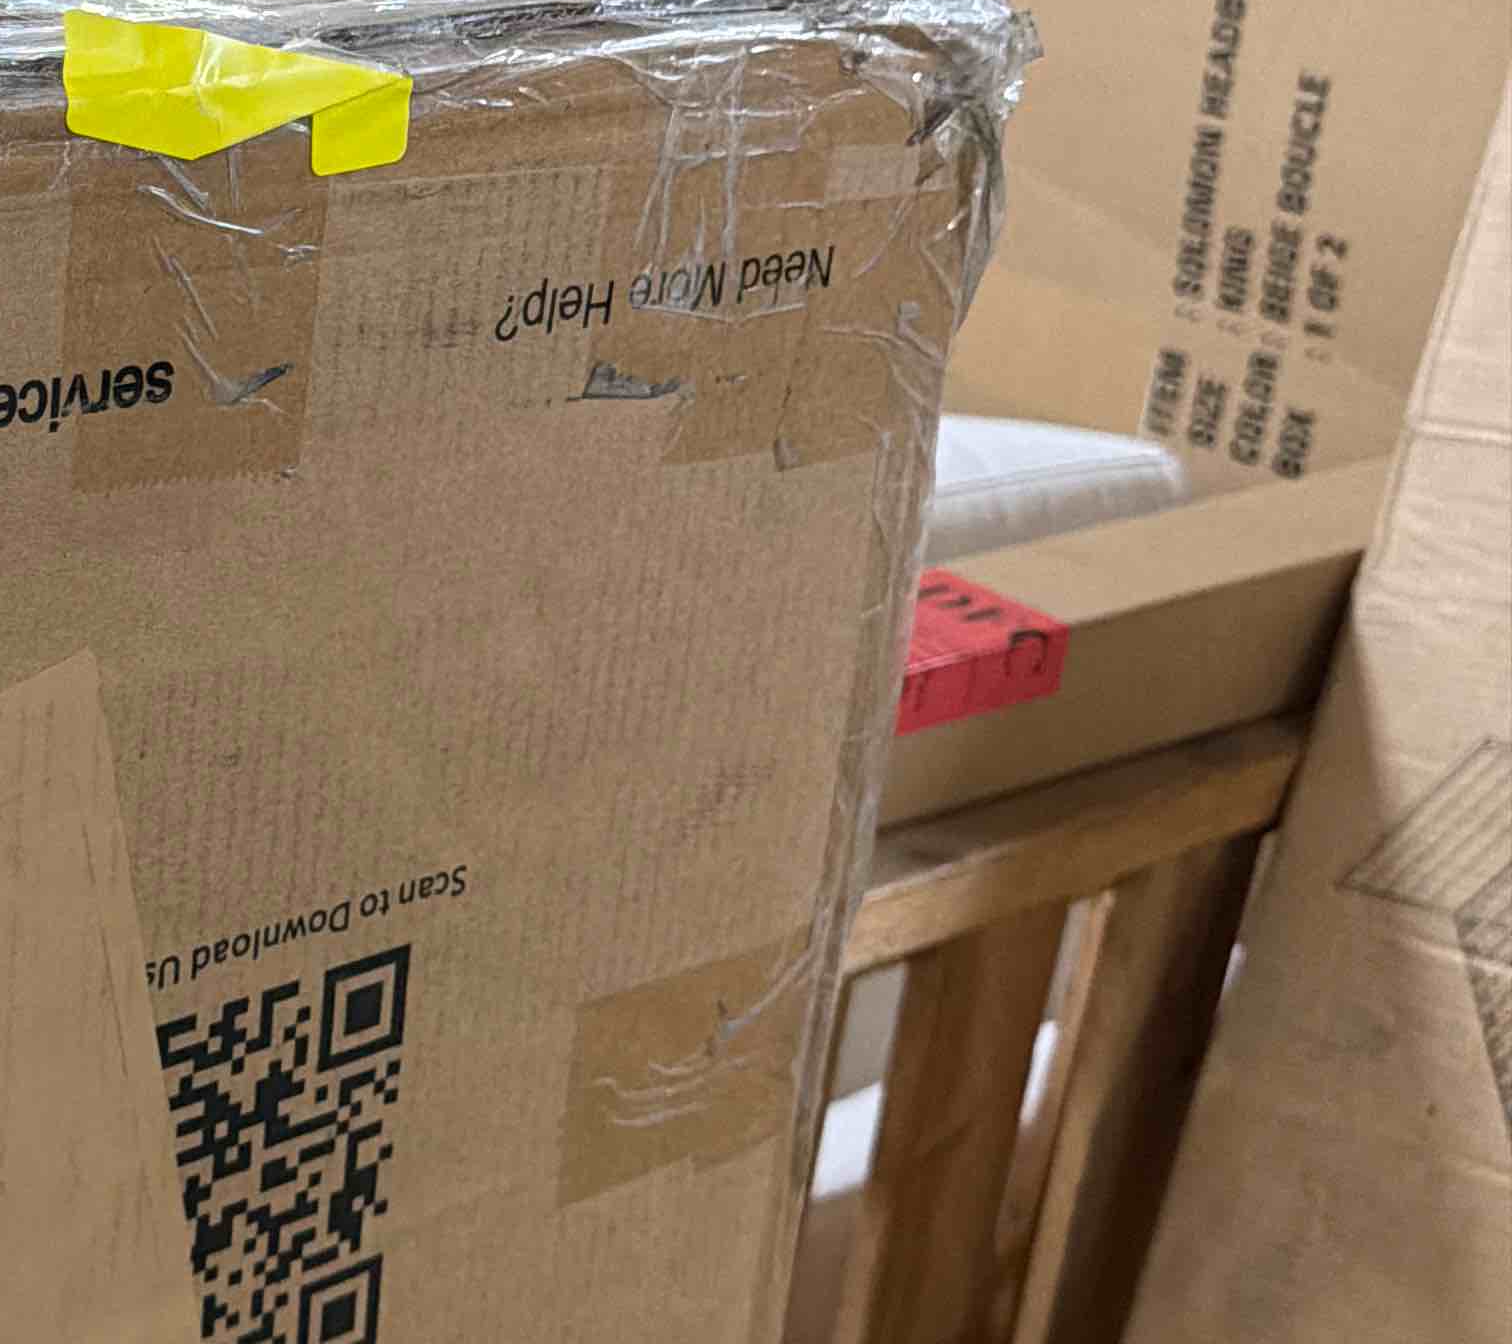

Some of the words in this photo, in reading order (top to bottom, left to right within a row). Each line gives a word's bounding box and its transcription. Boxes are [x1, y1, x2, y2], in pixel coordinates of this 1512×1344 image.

[1277, 70, 1331, 216] BOUCLE
[736, 244, 837, 294] Need
[1260, 212, 1309, 326] BEIGE
[1314, 233, 1350, 259] 2
[494, 279, 616, 344] Help?
[630, 261, 725, 311] More
[1144, 348, 1190, 437] ITEM
[1174, 123, 1223, 299] SOLOMON
[1307, 268, 1344, 314] OF
[1187, 376, 1228, 448] SIZE
[1217, 226, 1256, 315] KING
[1229, 350, 1279, 467] COLOR
[1270, 408, 1316, 481] BOX
[360, 885, 392, 917] to
[398, 864, 469, 907] Scan
[190, 898, 351, 964] Download
